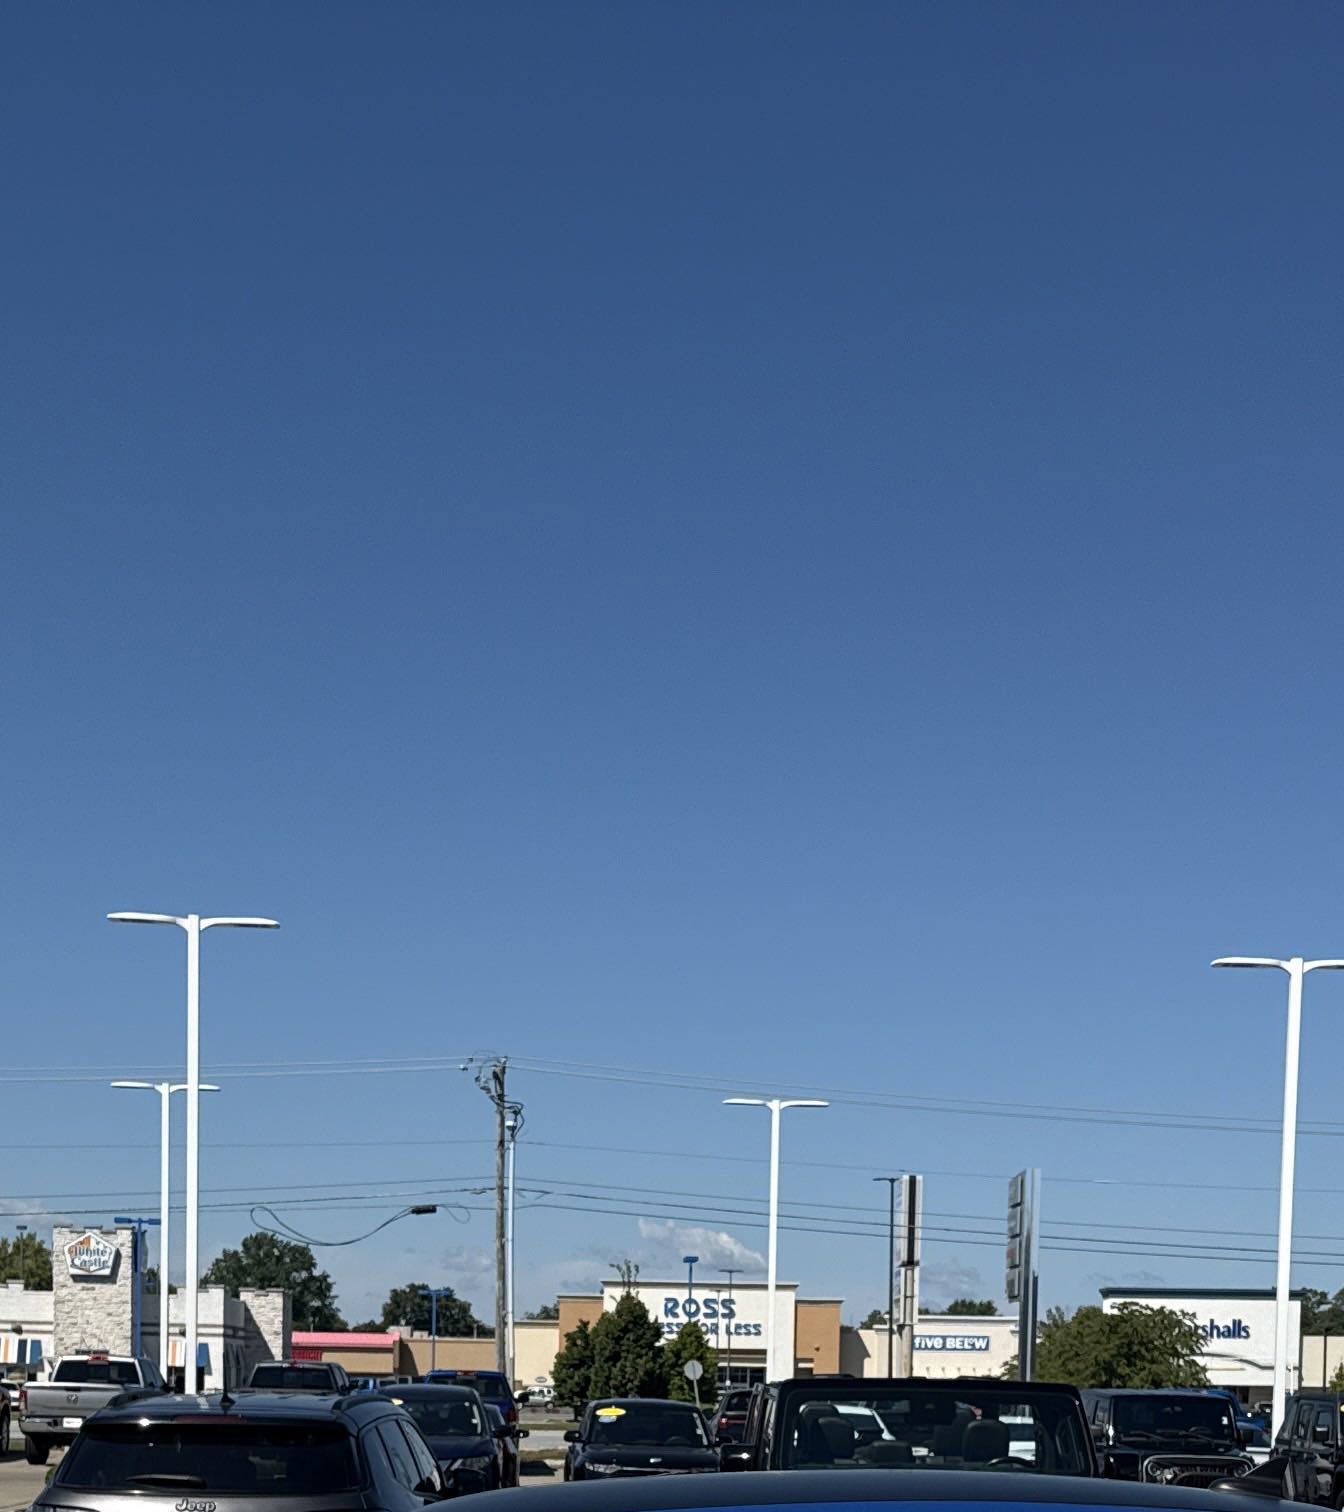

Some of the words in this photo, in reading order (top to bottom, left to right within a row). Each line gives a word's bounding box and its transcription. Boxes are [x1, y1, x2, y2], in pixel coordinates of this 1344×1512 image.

[67, 1245, 108, 1257] White
[70, 1257, 111, 1268] Castle
[664, 1298, 736, 1319] ROSS
[725, 1323, 762, 1336] LESS
[914, 1337, 943, 1349] five
